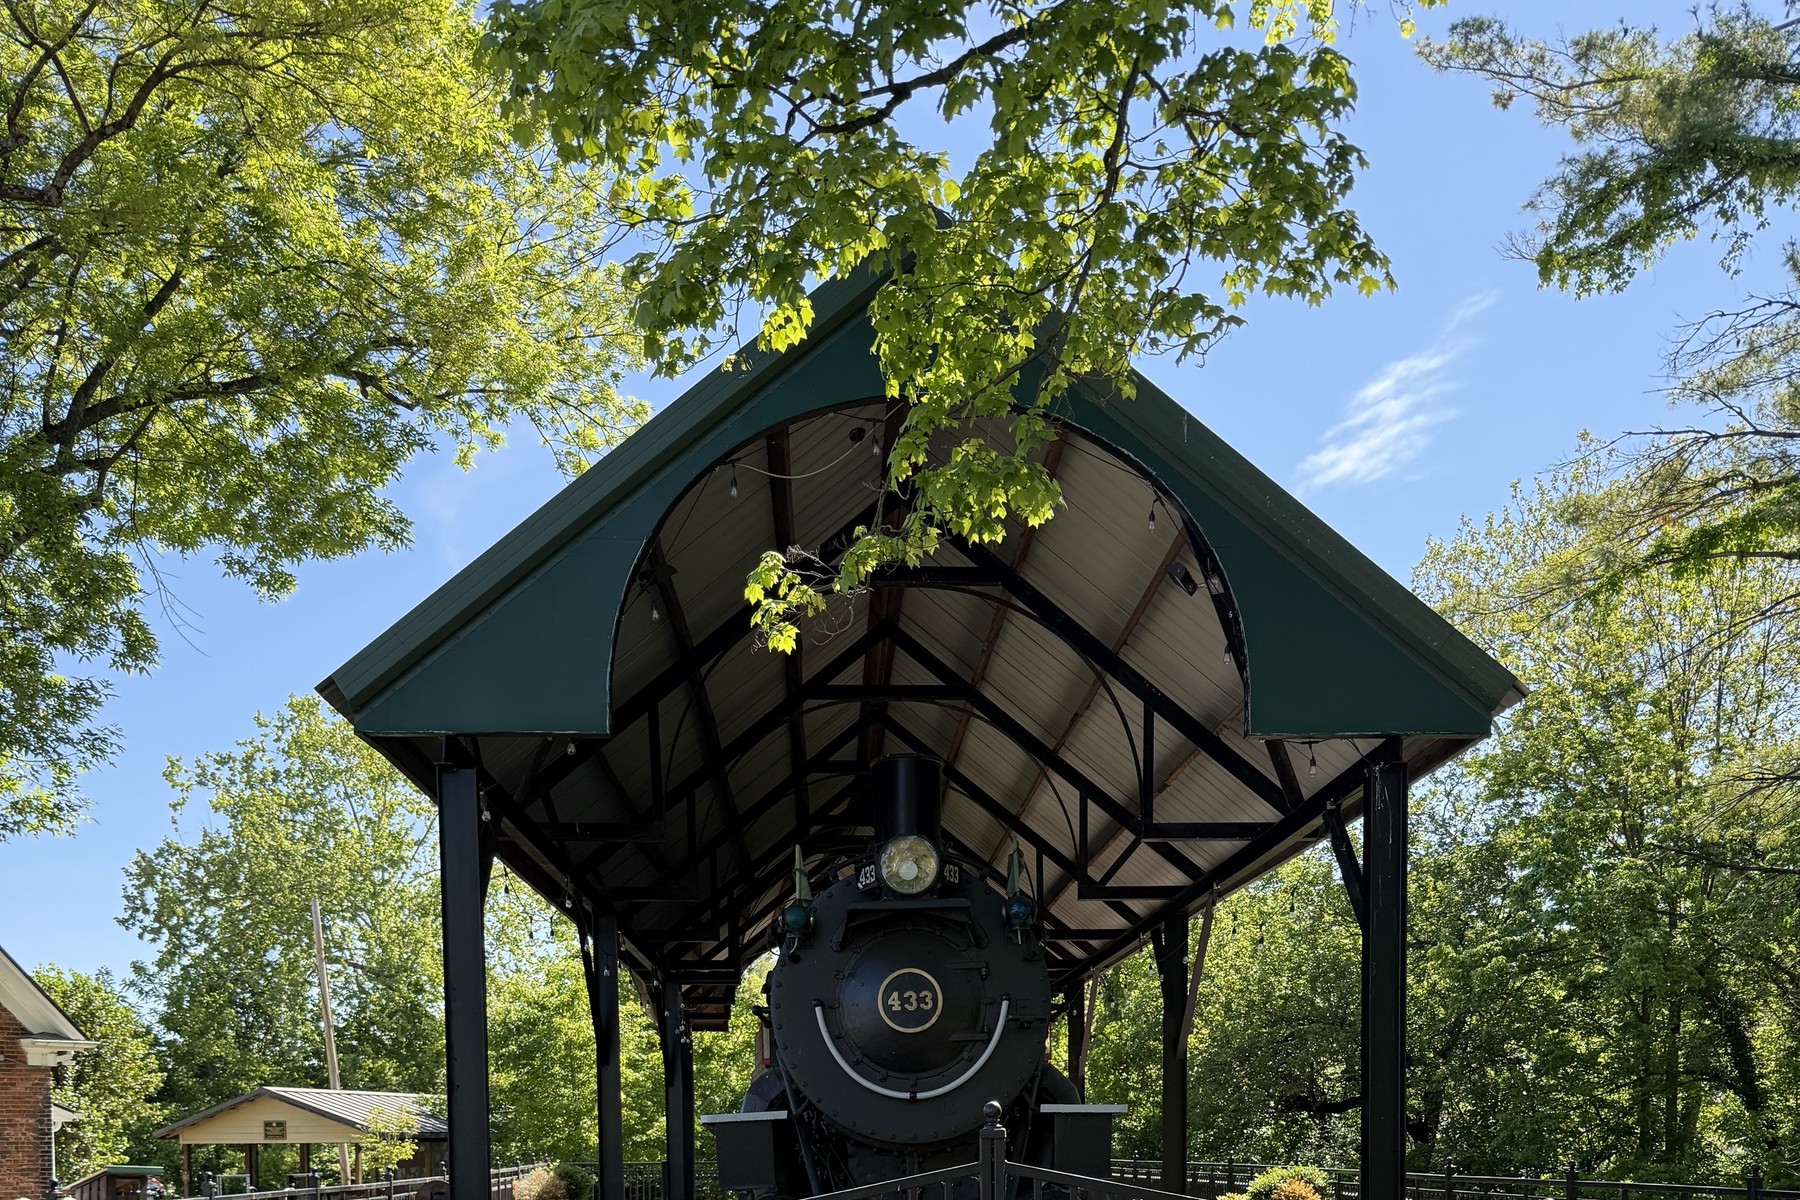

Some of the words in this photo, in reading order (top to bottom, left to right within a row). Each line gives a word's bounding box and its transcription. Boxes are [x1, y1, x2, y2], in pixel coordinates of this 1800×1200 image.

[859, 864, 876, 886] 433
[944, 863, 960, 884] 433
[887, 990, 934, 1012] 433
